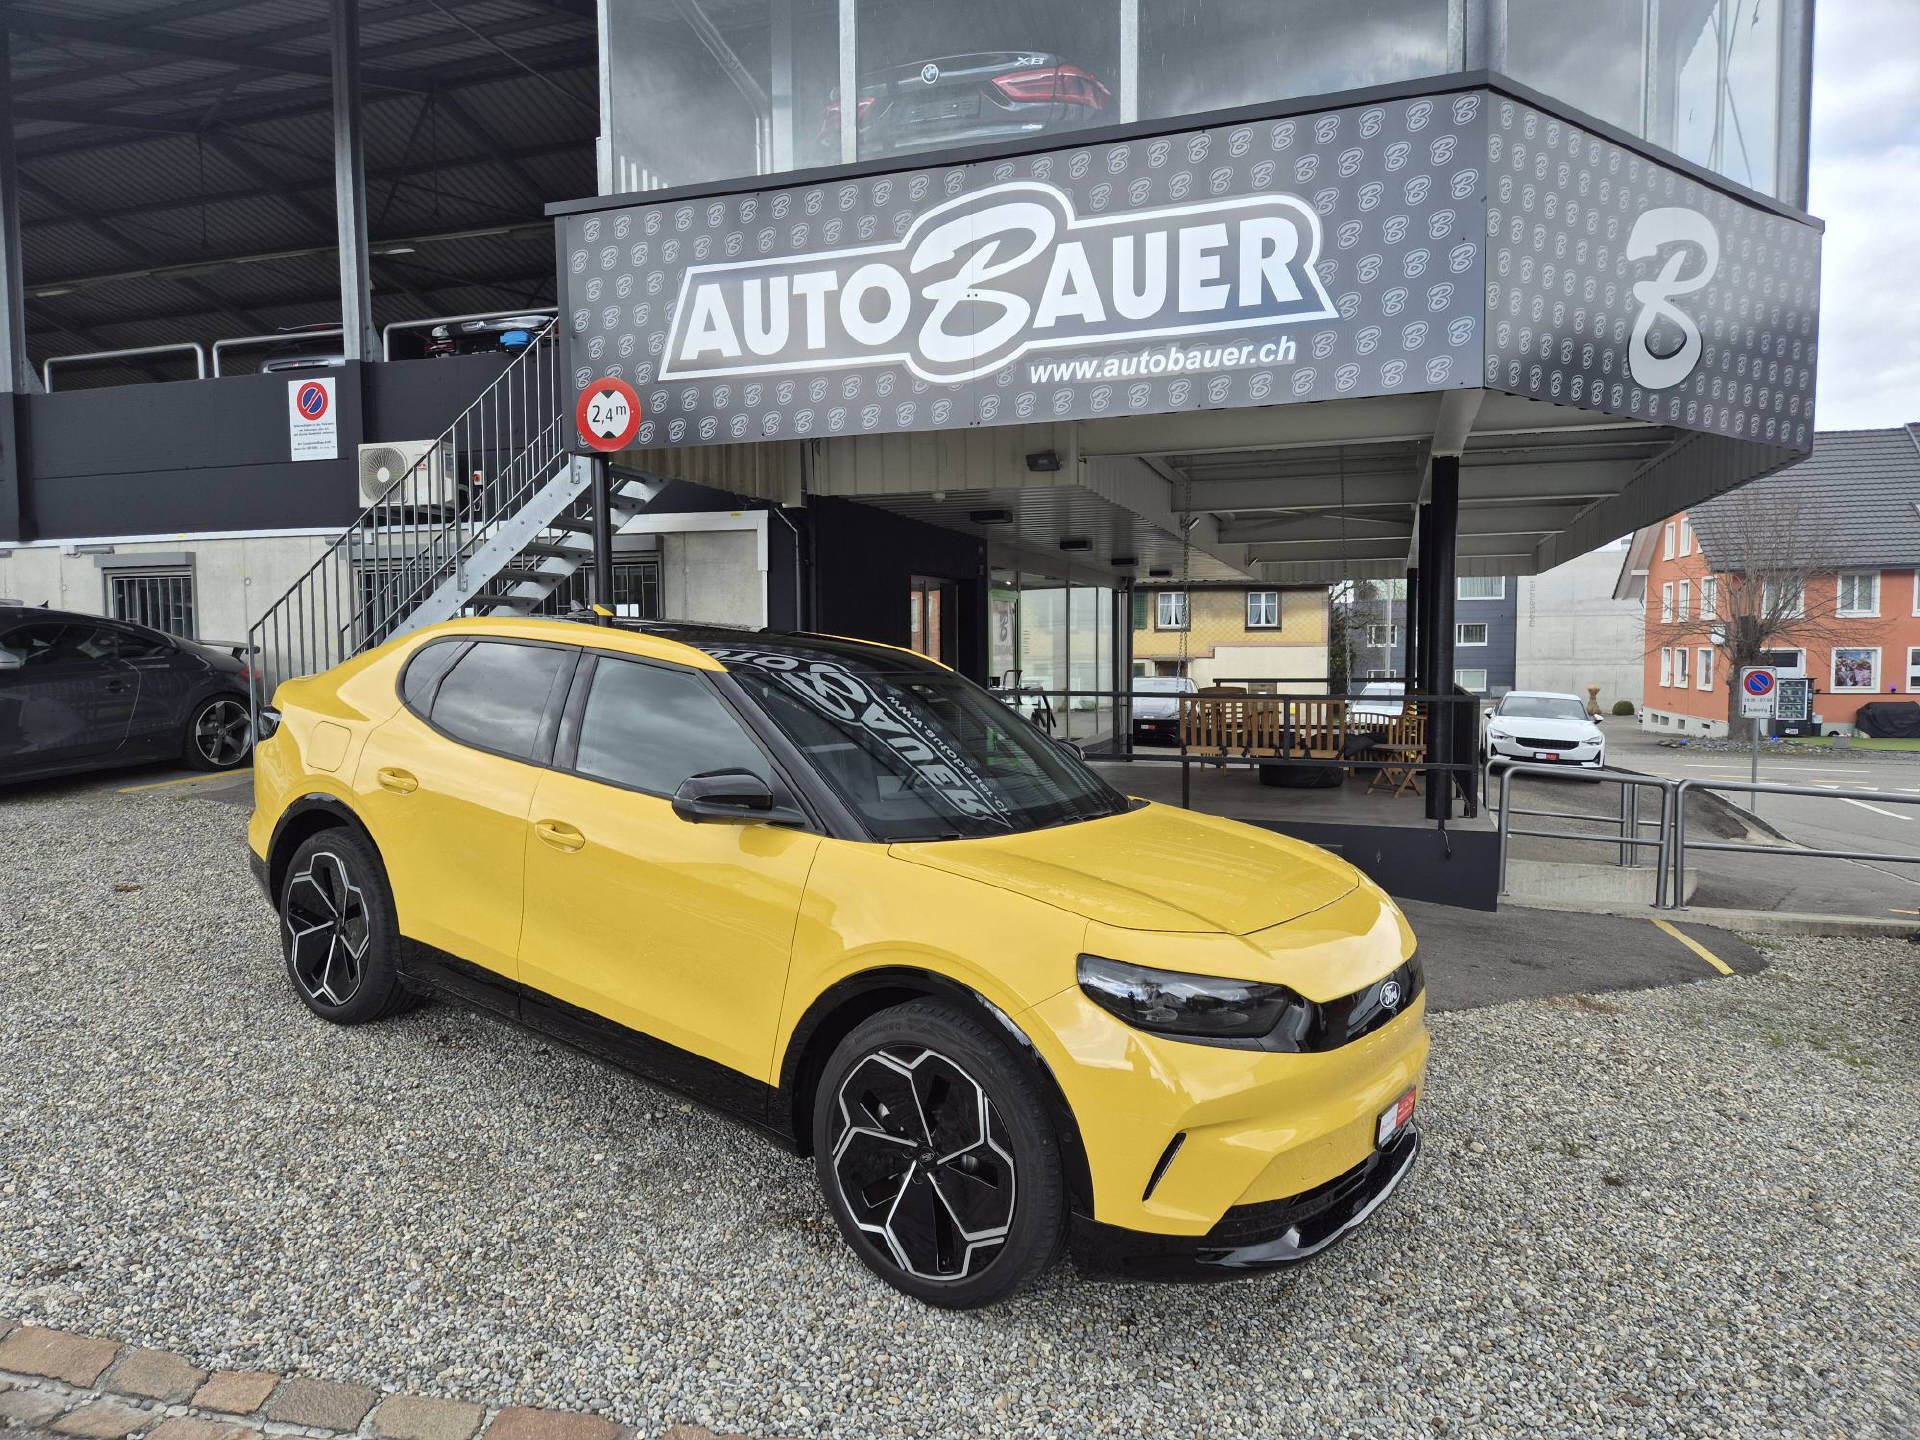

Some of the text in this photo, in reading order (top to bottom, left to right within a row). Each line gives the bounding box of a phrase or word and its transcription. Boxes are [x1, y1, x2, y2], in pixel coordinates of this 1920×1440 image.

[680, 202, 1304, 361] AUTO BAUER
[1030, 336, 1297, 385] www.autobauer.ch
[1627, 208, 1719, 389] B
